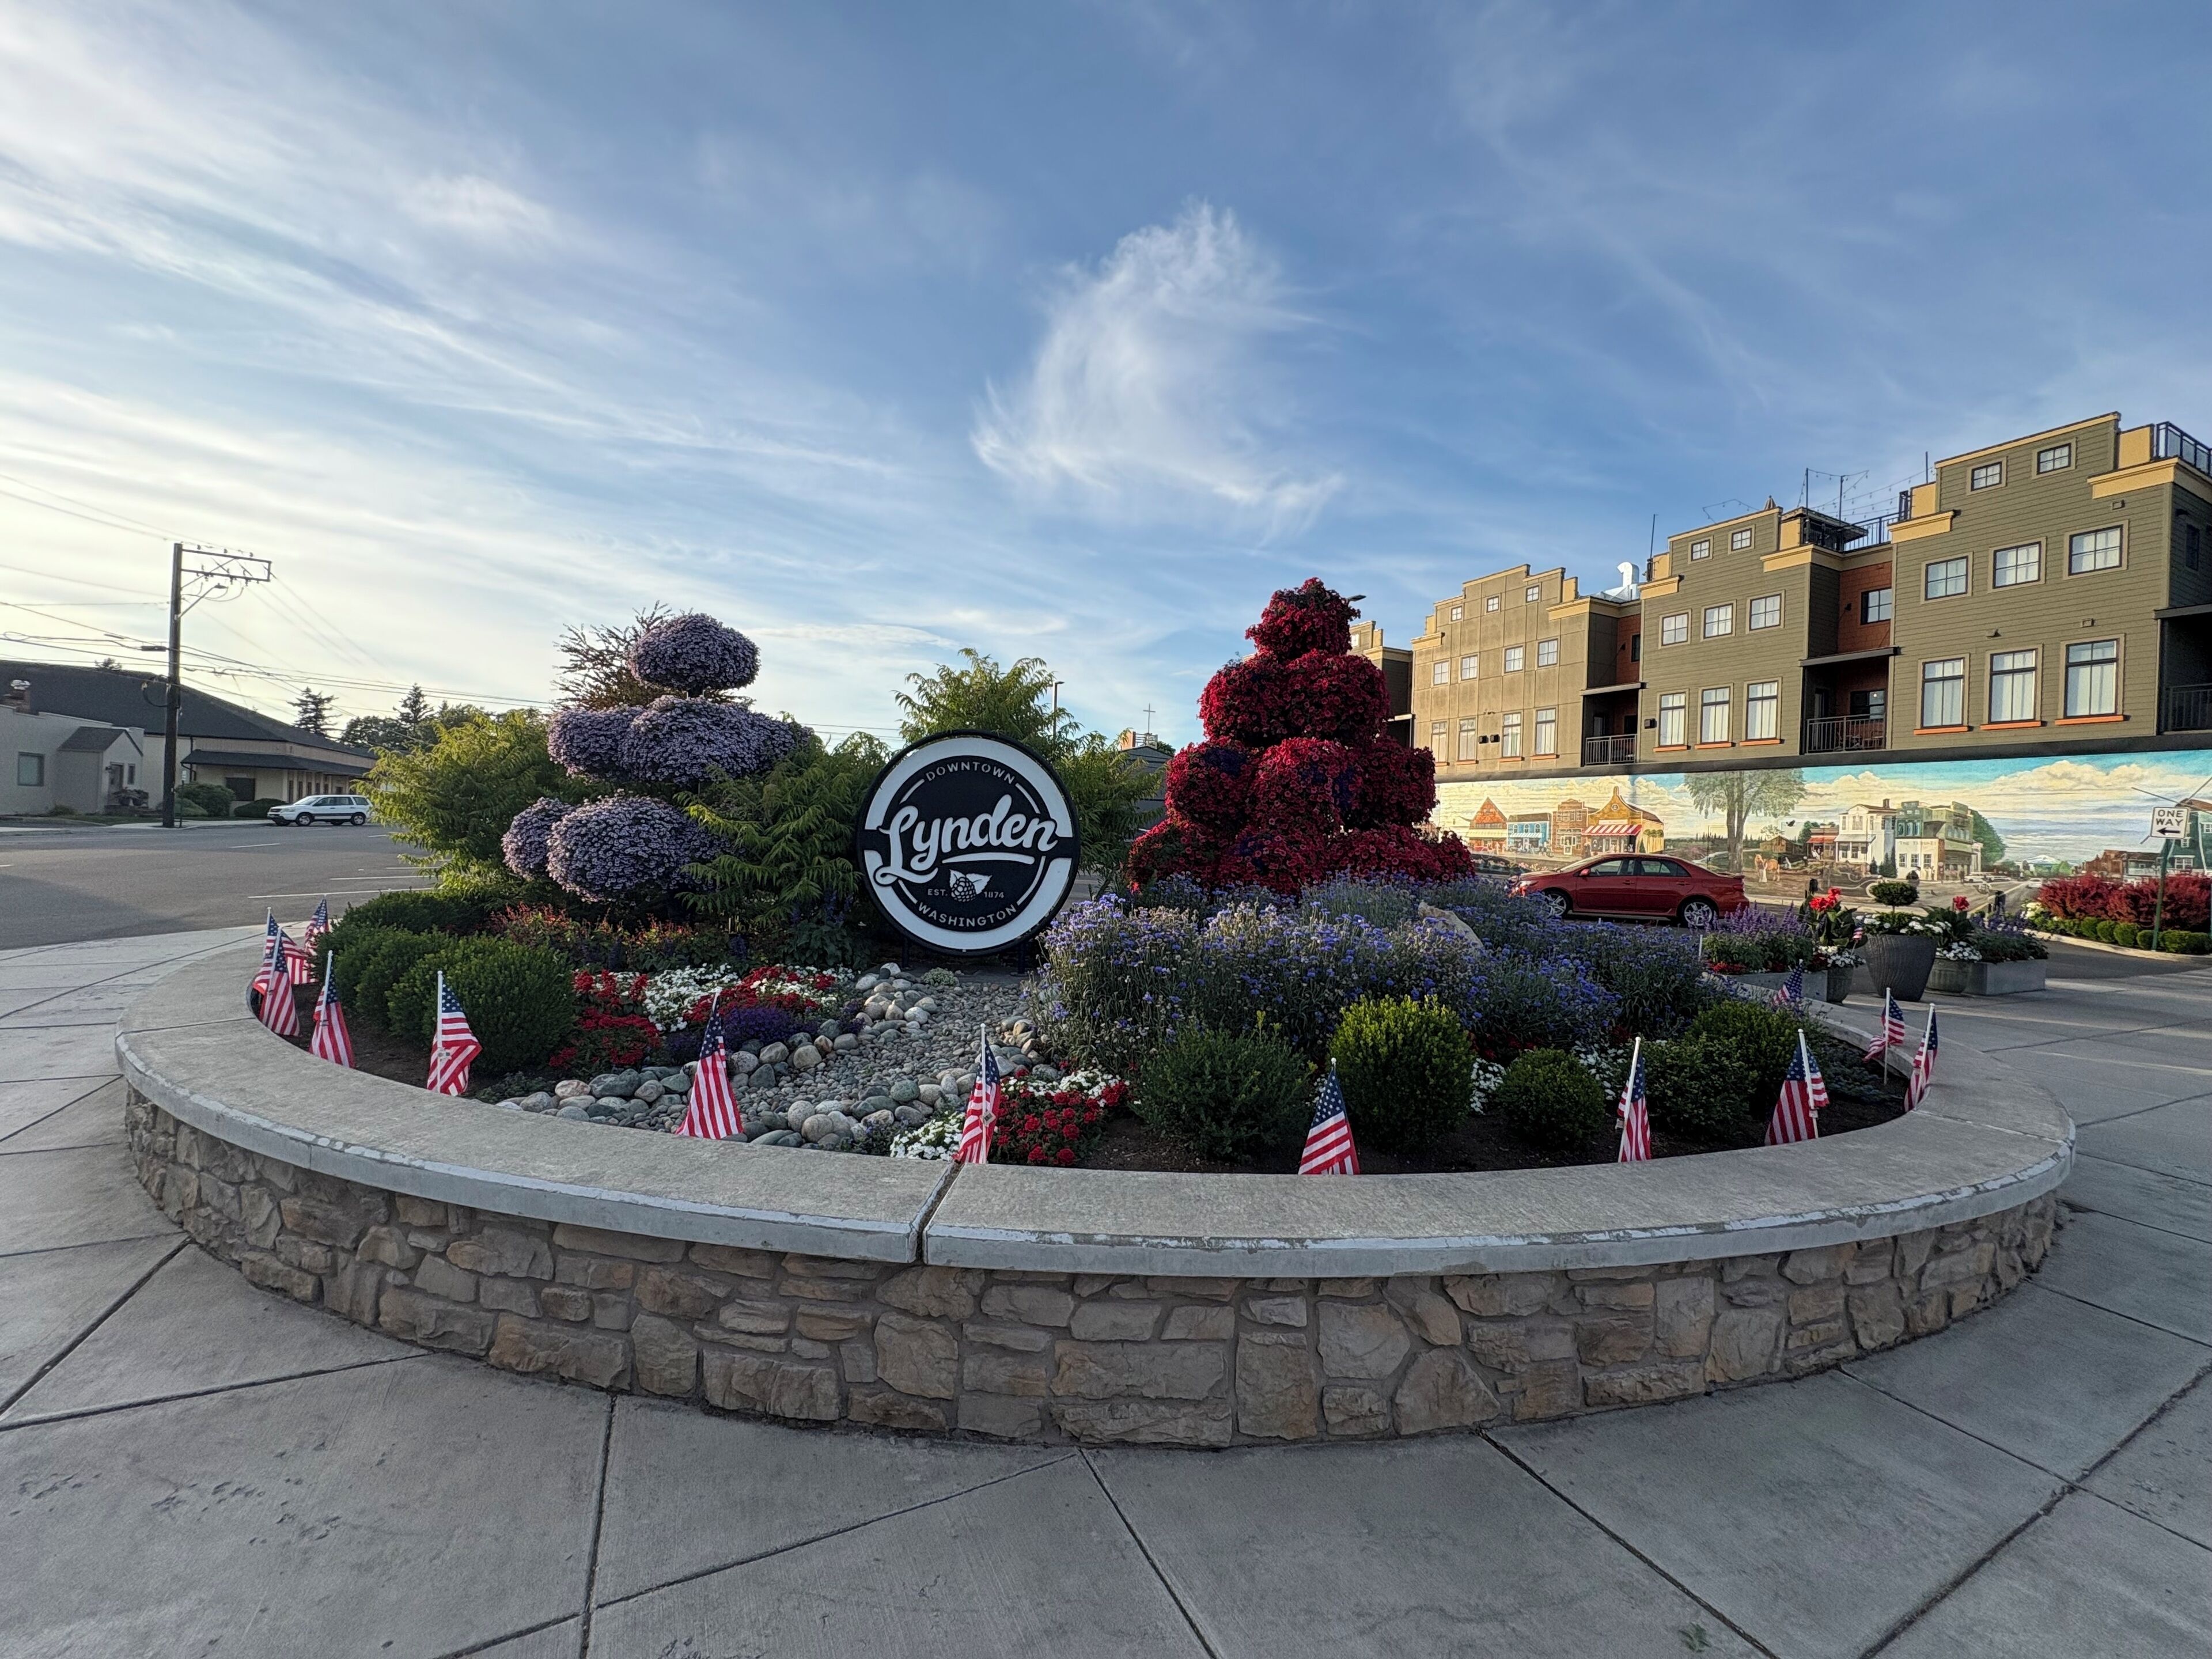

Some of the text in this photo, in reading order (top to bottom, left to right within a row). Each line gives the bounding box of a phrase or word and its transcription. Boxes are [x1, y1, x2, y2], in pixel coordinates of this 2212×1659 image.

[926, 761, 1015, 784] DOWNTOWN
[2157, 809, 2184, 818] ONE
[874, 794, 1058, 884] Lynden
[927, 888, 948, 896] EST.
[918, 902, 1017, 927] WASHINGTON
